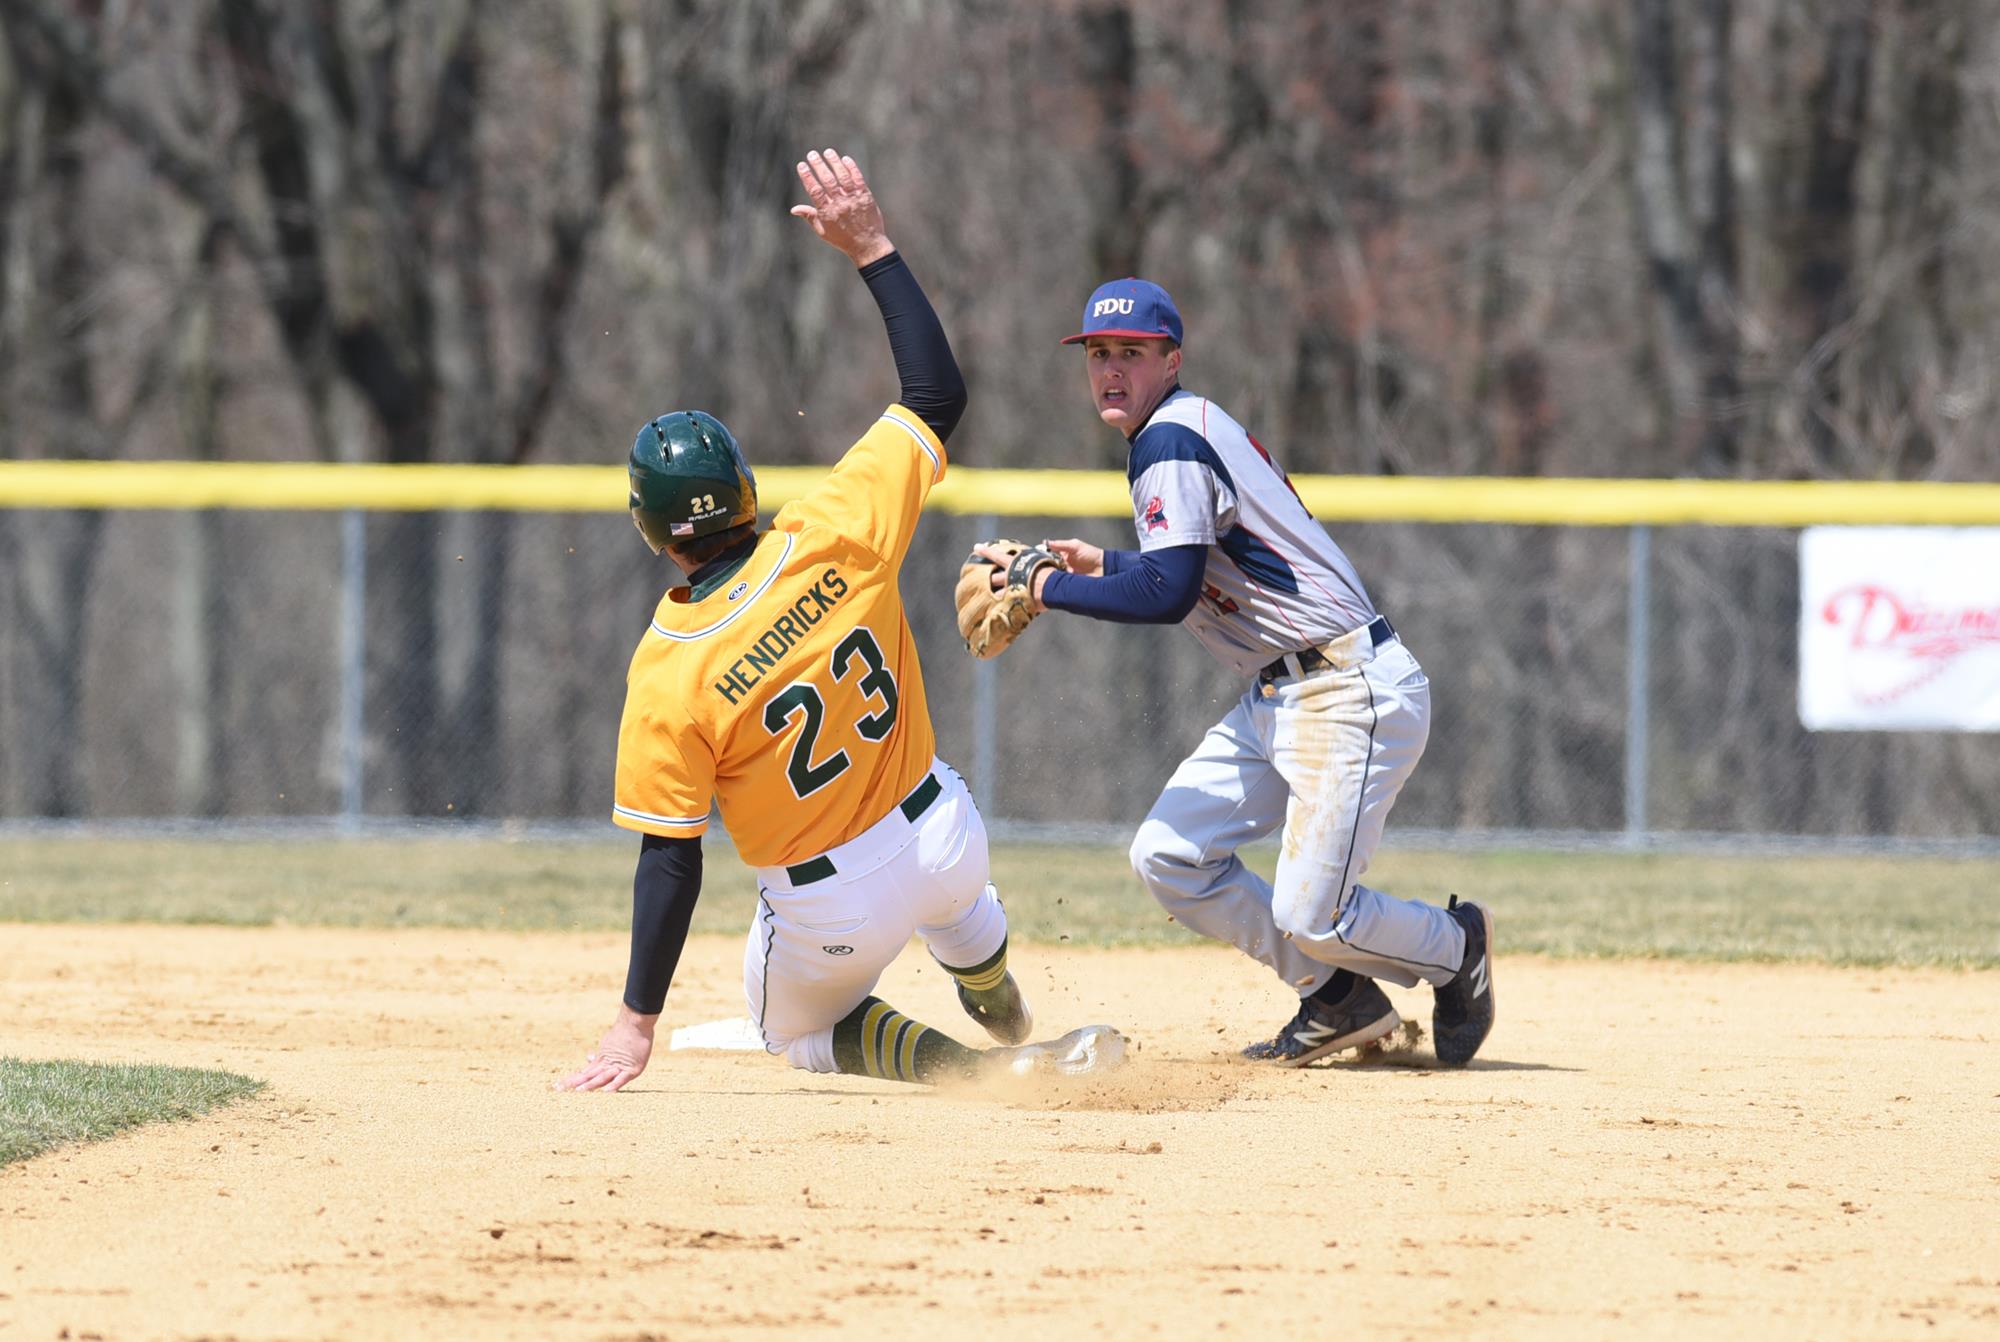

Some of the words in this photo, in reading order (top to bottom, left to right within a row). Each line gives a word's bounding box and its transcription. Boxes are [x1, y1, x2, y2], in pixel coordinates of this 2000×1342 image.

[1093, 298, 1135, 317] FDU
[691, 494, 716, 514] 23
[714, 568, 848, 705] HENDRICKS
[762, 625, 898, 800] 23
